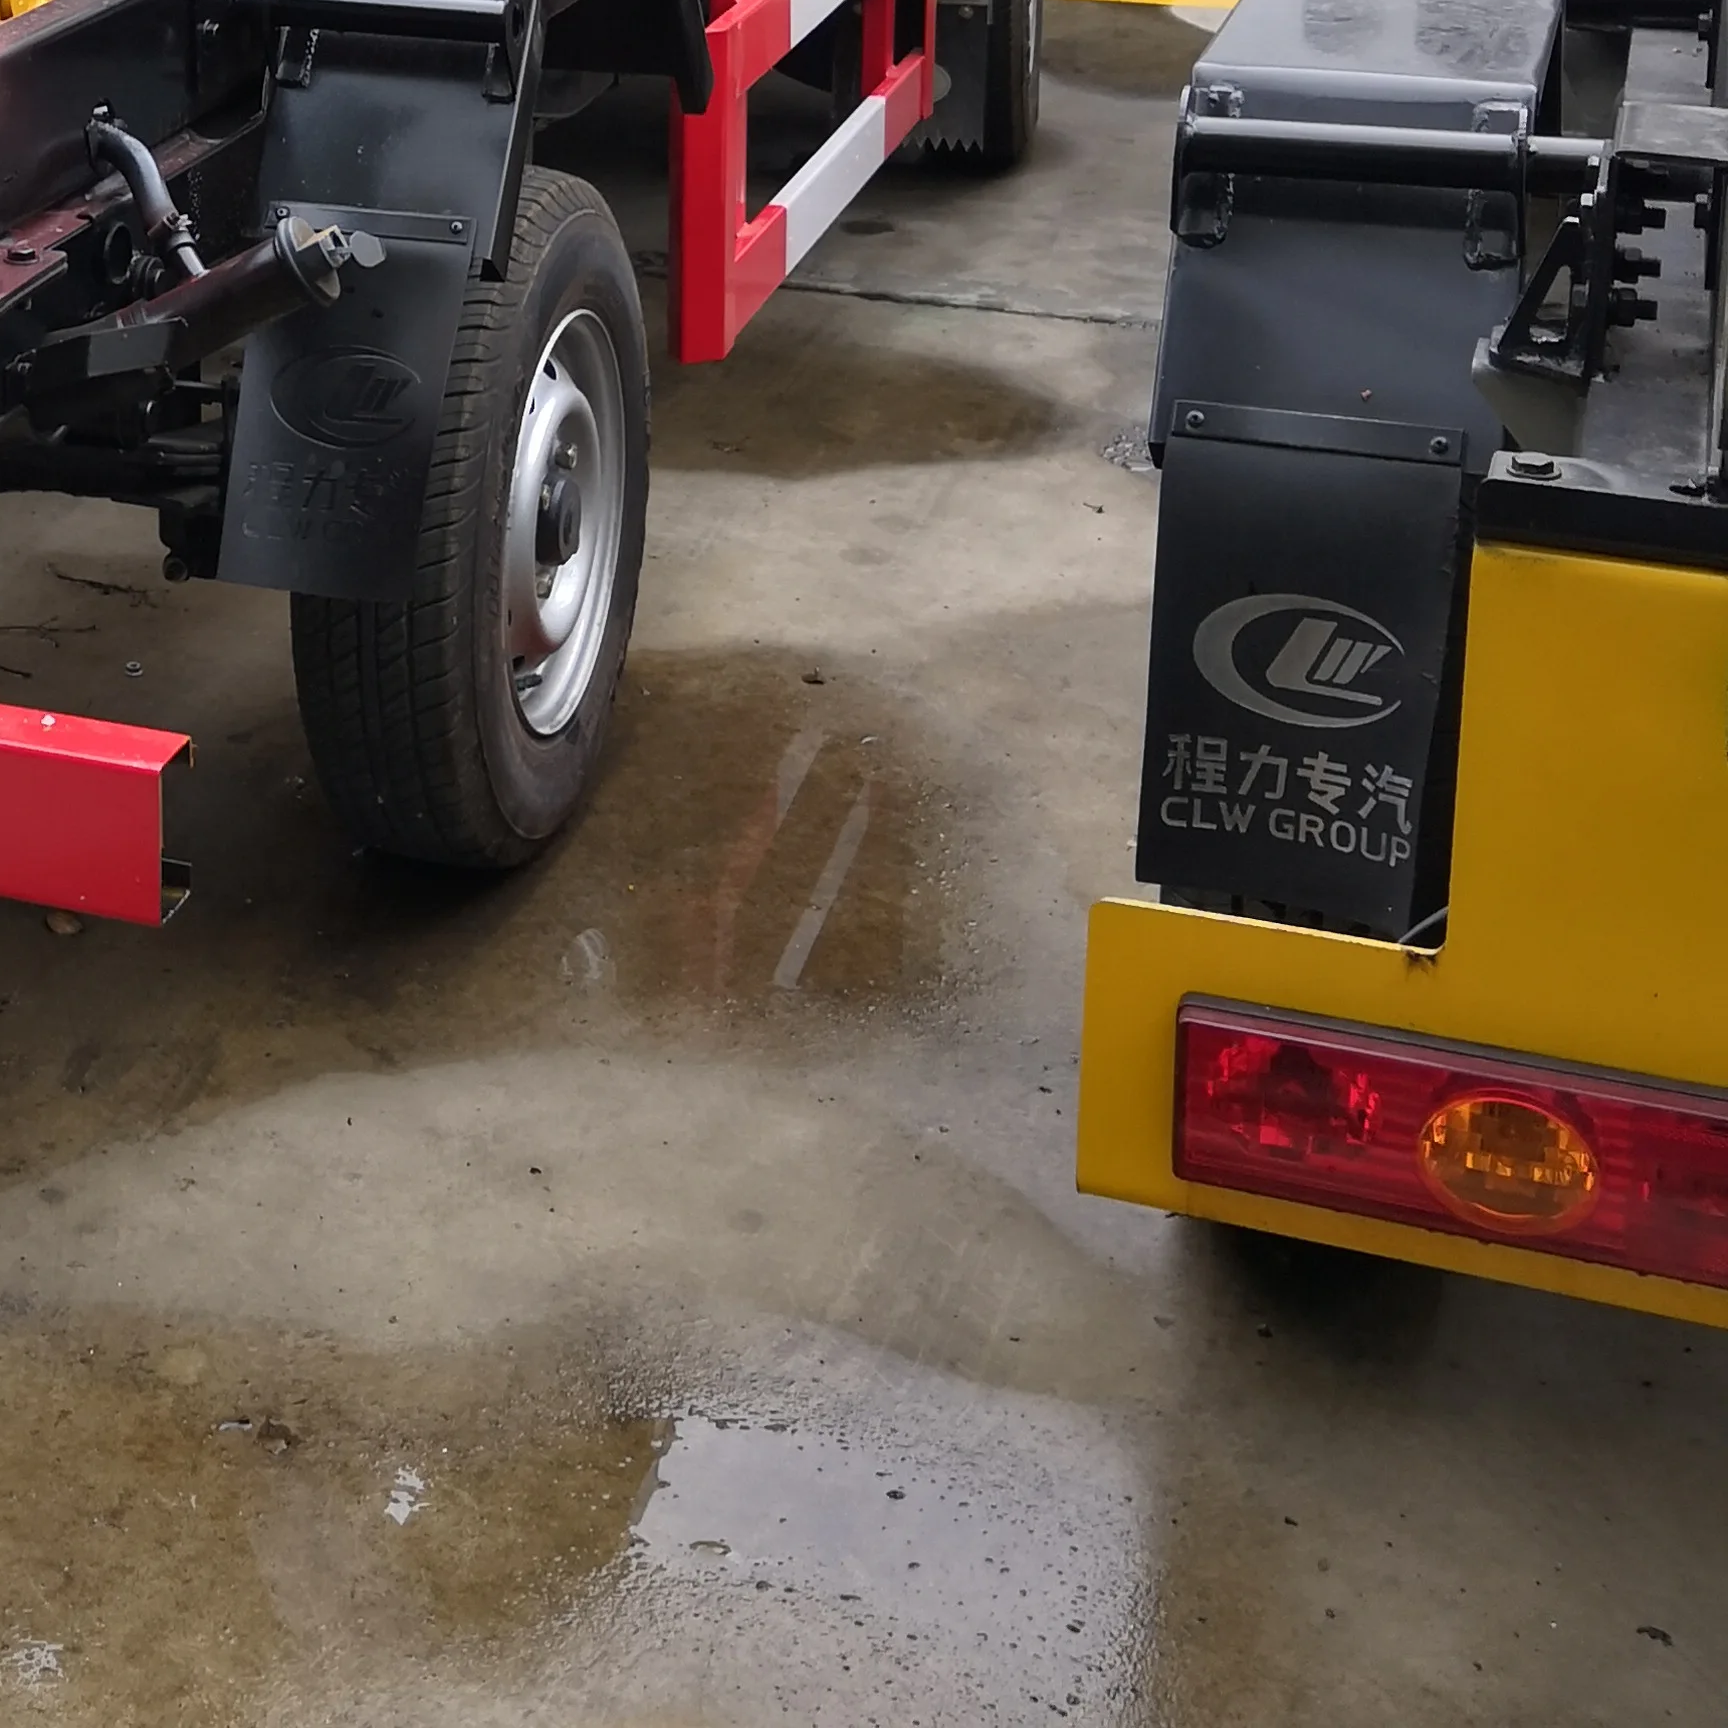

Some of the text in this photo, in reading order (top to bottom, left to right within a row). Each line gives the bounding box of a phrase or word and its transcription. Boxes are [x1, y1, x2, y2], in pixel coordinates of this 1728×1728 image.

[1162, 733, 1413, 835] 程力专汽
[1160, 796, 1411, 867] CLW GROUP
